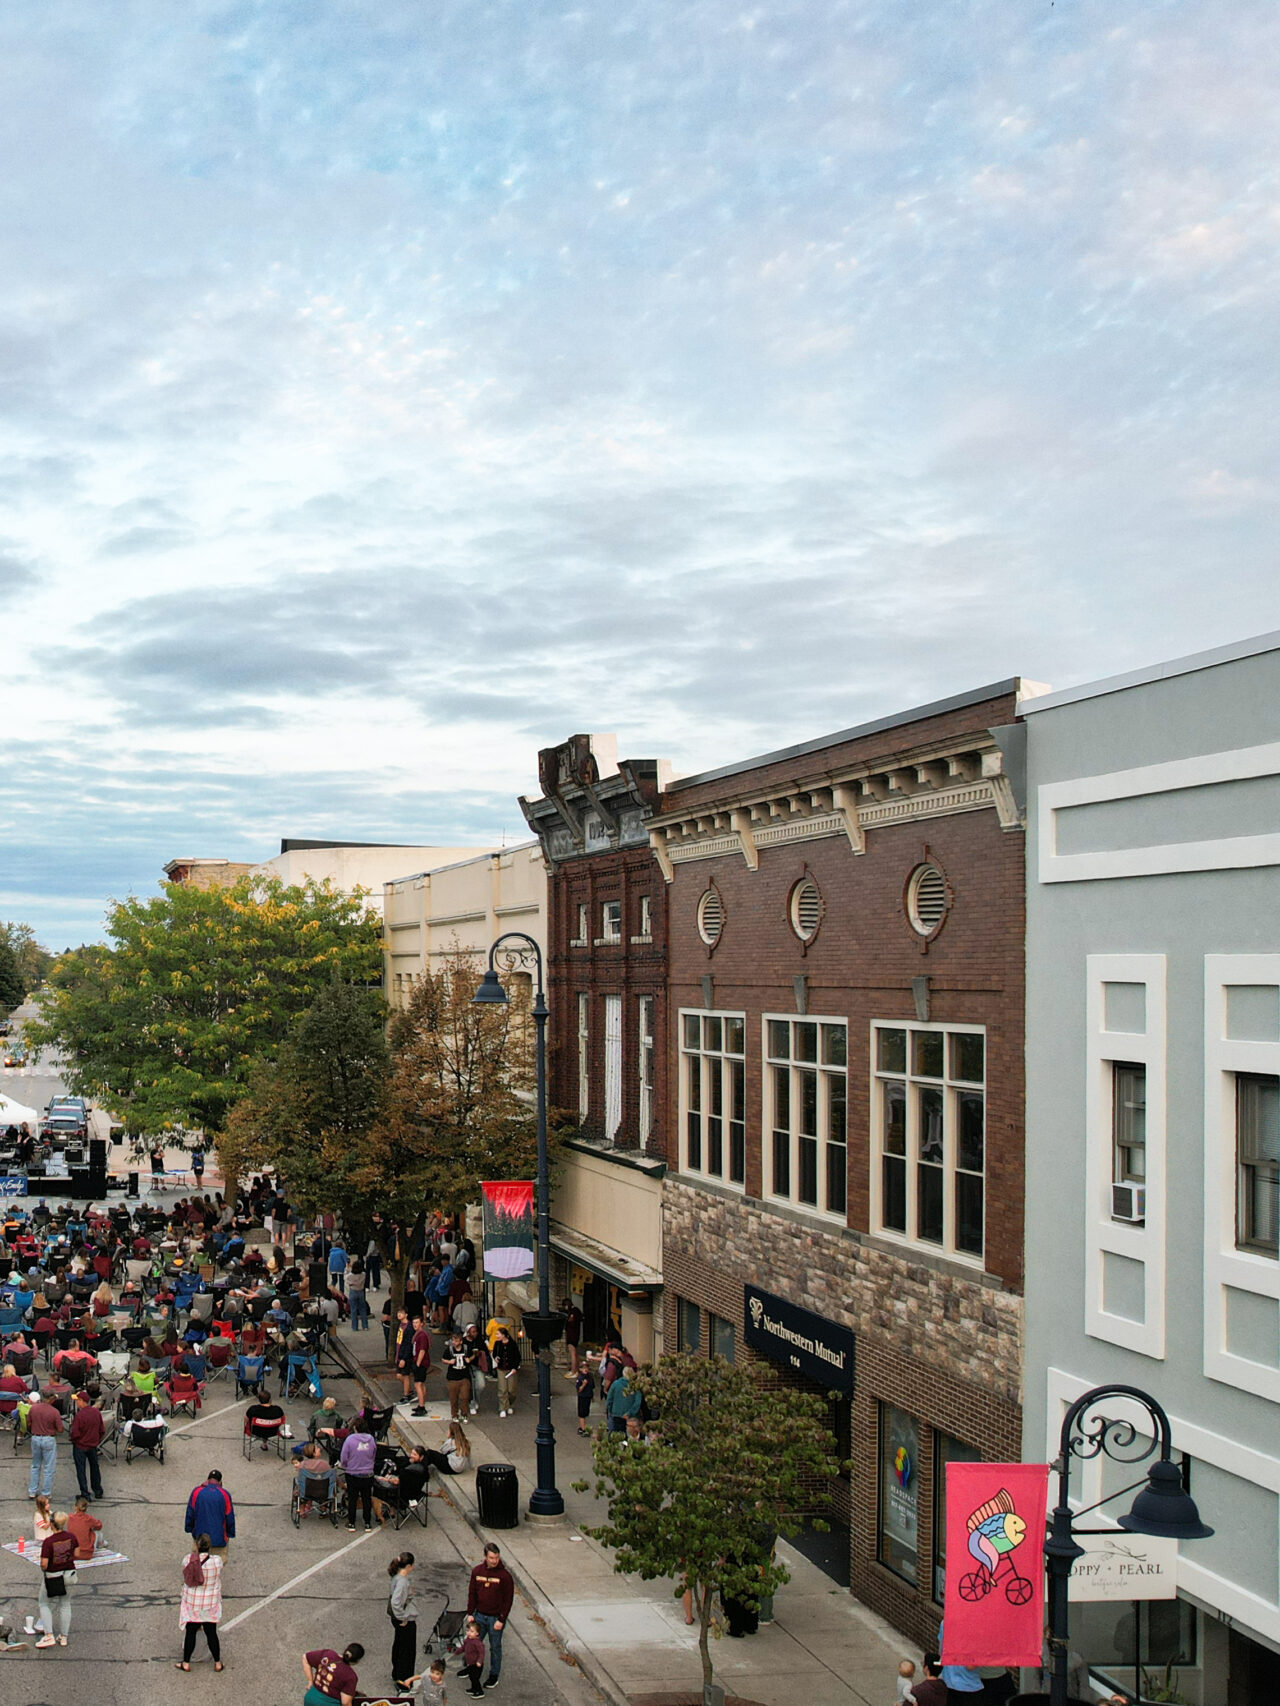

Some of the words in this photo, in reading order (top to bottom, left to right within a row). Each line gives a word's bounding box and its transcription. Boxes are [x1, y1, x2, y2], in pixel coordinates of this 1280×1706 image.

[763, 1314, 814, 1354] Northwestern
[790, 1354, 801, 1368] 114
[1119, 1564, 1163, 1575] PEARL
